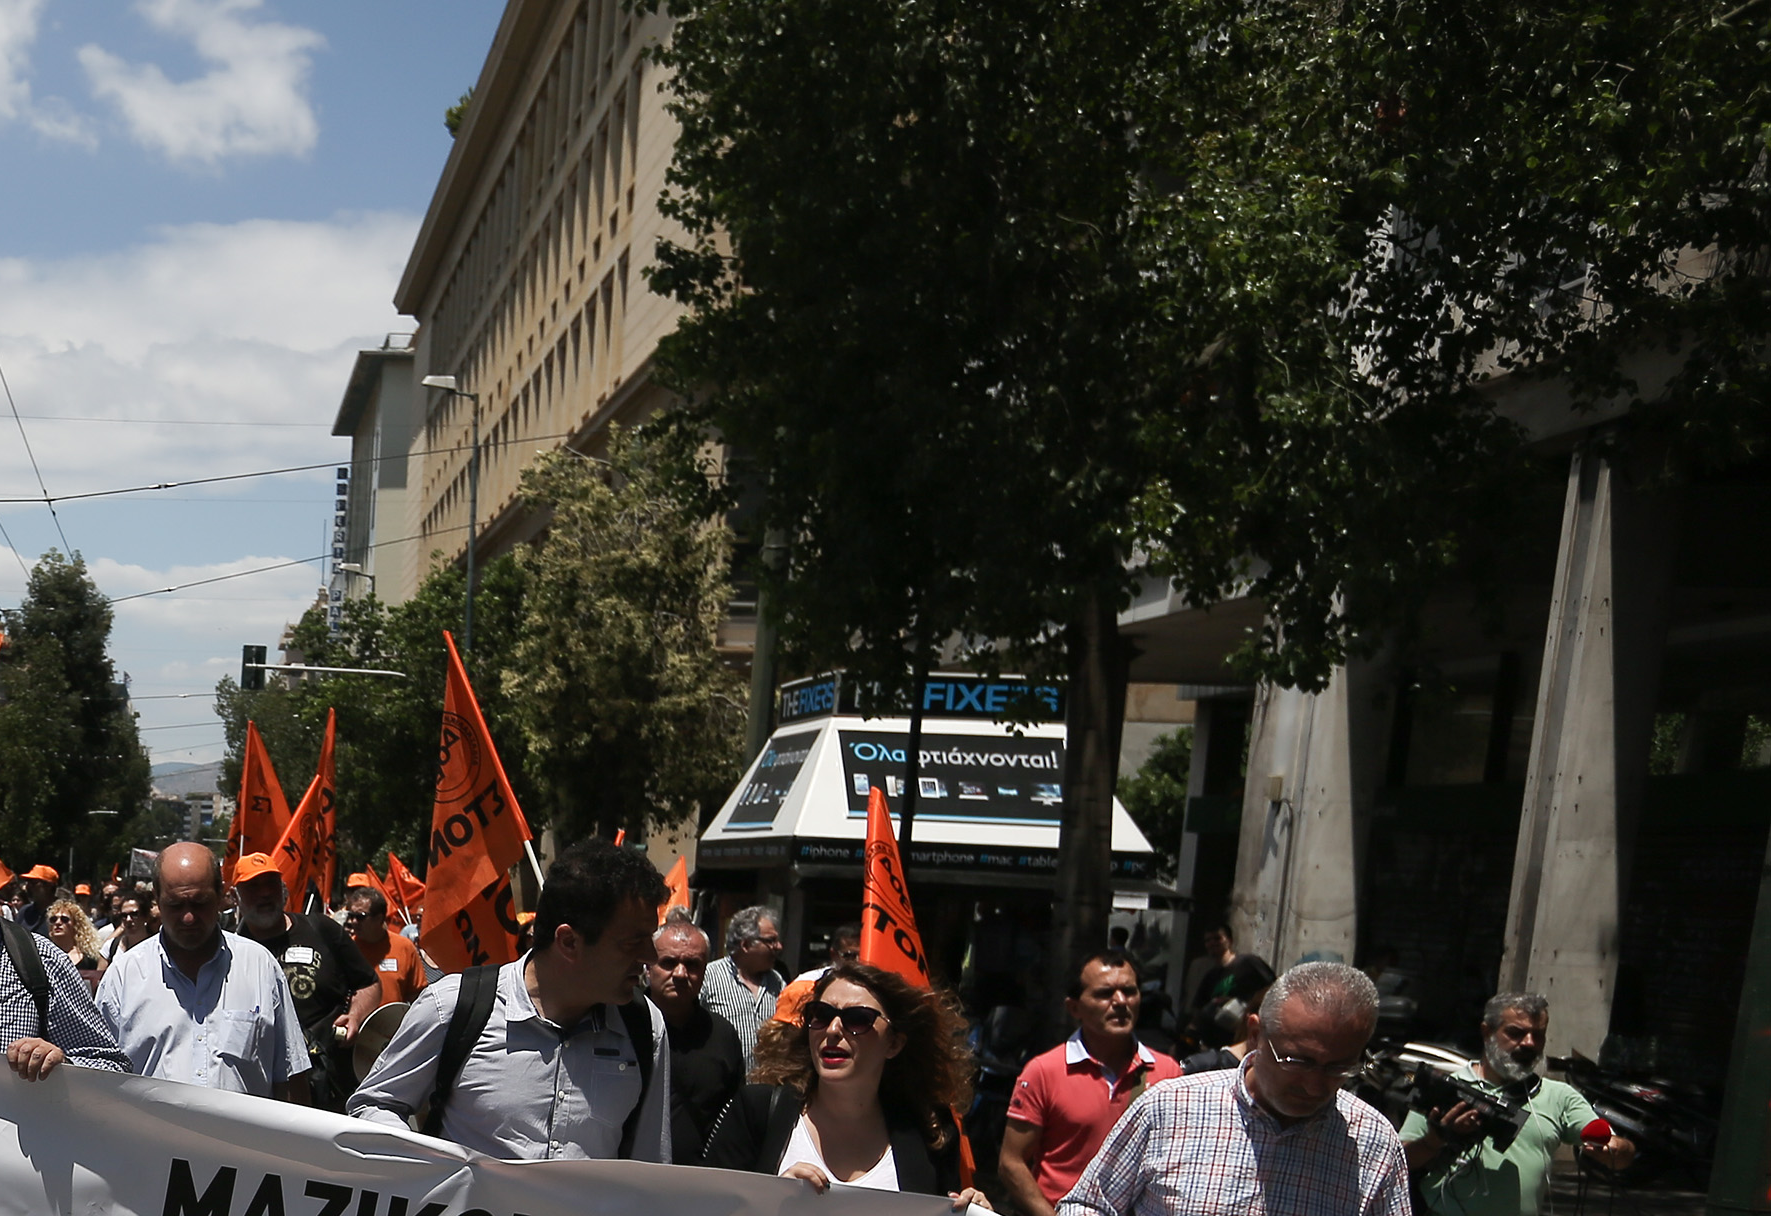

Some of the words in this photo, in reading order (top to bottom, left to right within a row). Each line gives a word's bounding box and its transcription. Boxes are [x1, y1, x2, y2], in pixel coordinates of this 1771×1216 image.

[329, 590, 342, 636] PAL
[923, 682, 1059, 713] FIXES
[801, 845, 850, 859] #iphone
[1017, 854, 1059, 868] #table
